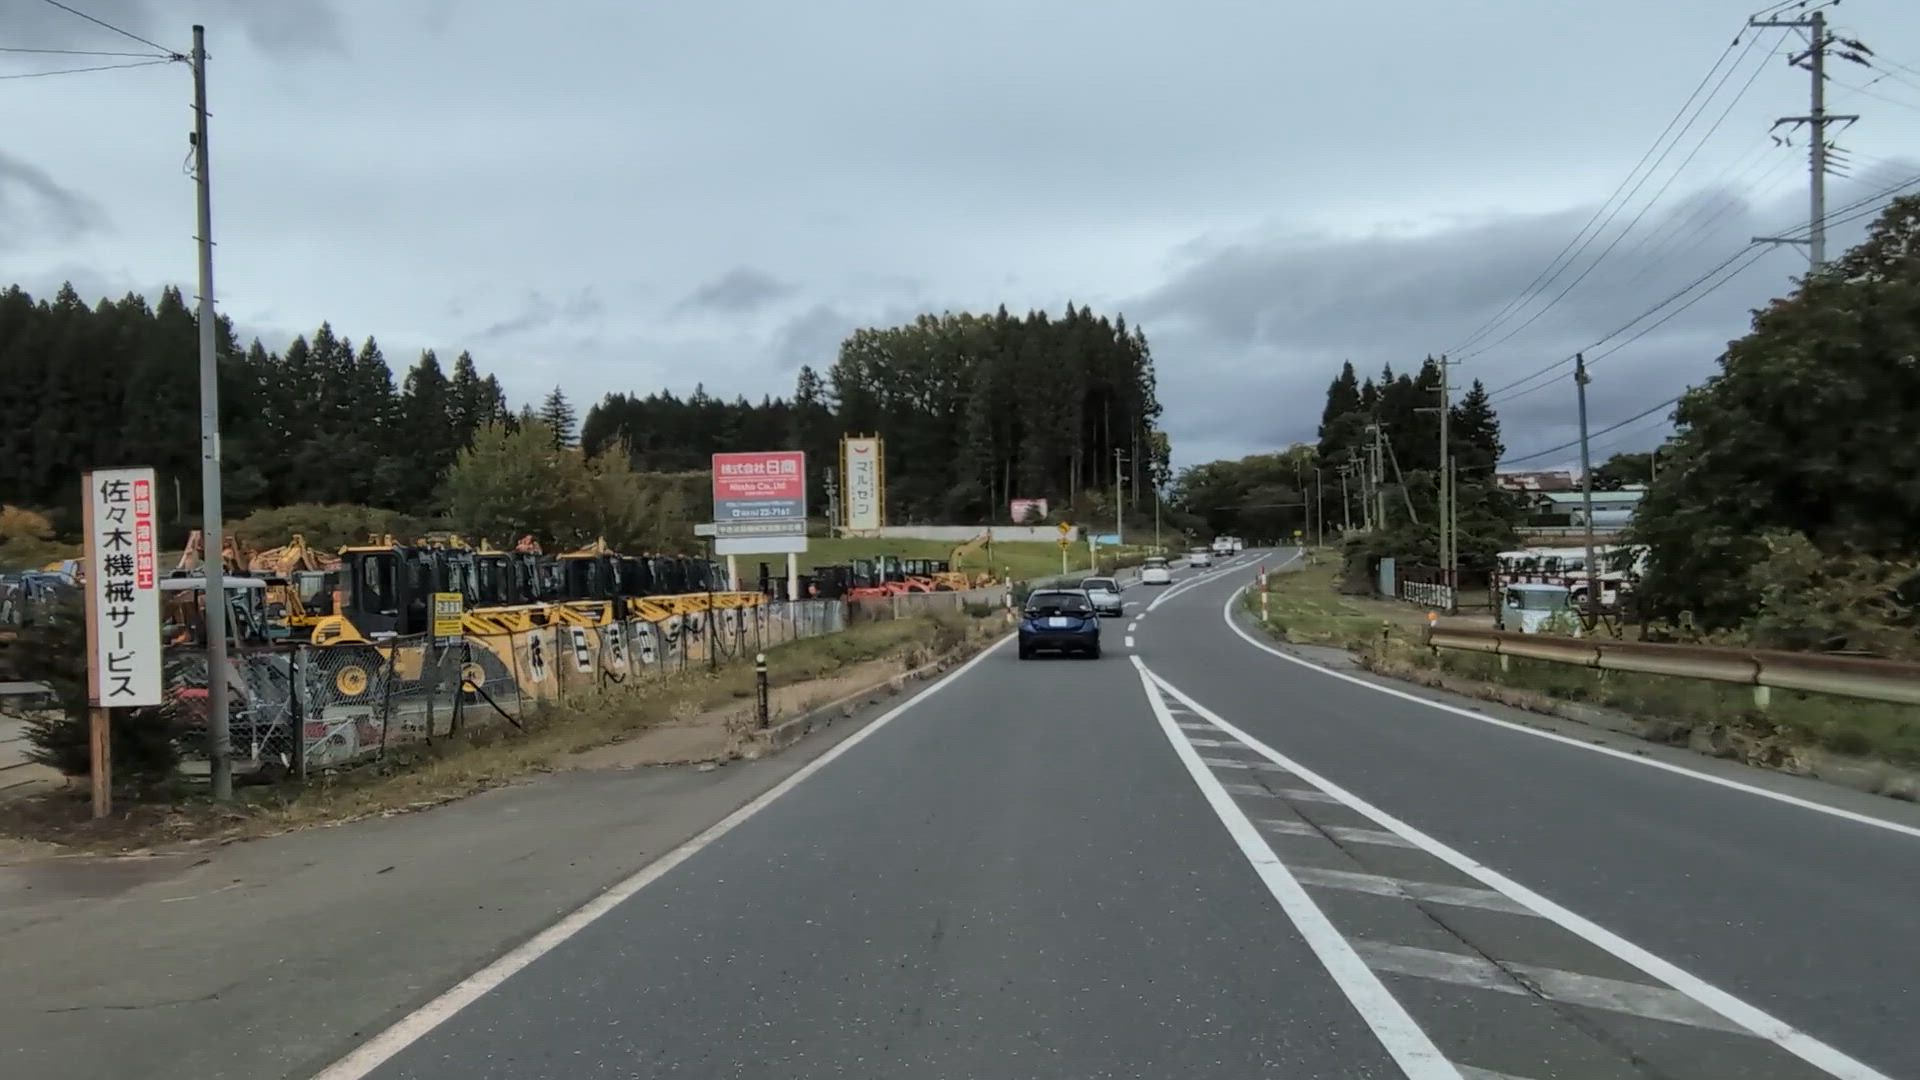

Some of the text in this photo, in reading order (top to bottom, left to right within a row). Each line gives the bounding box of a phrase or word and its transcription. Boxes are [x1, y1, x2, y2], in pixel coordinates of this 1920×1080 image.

[100, 479, 136, 697] 佐々木機械サービス
